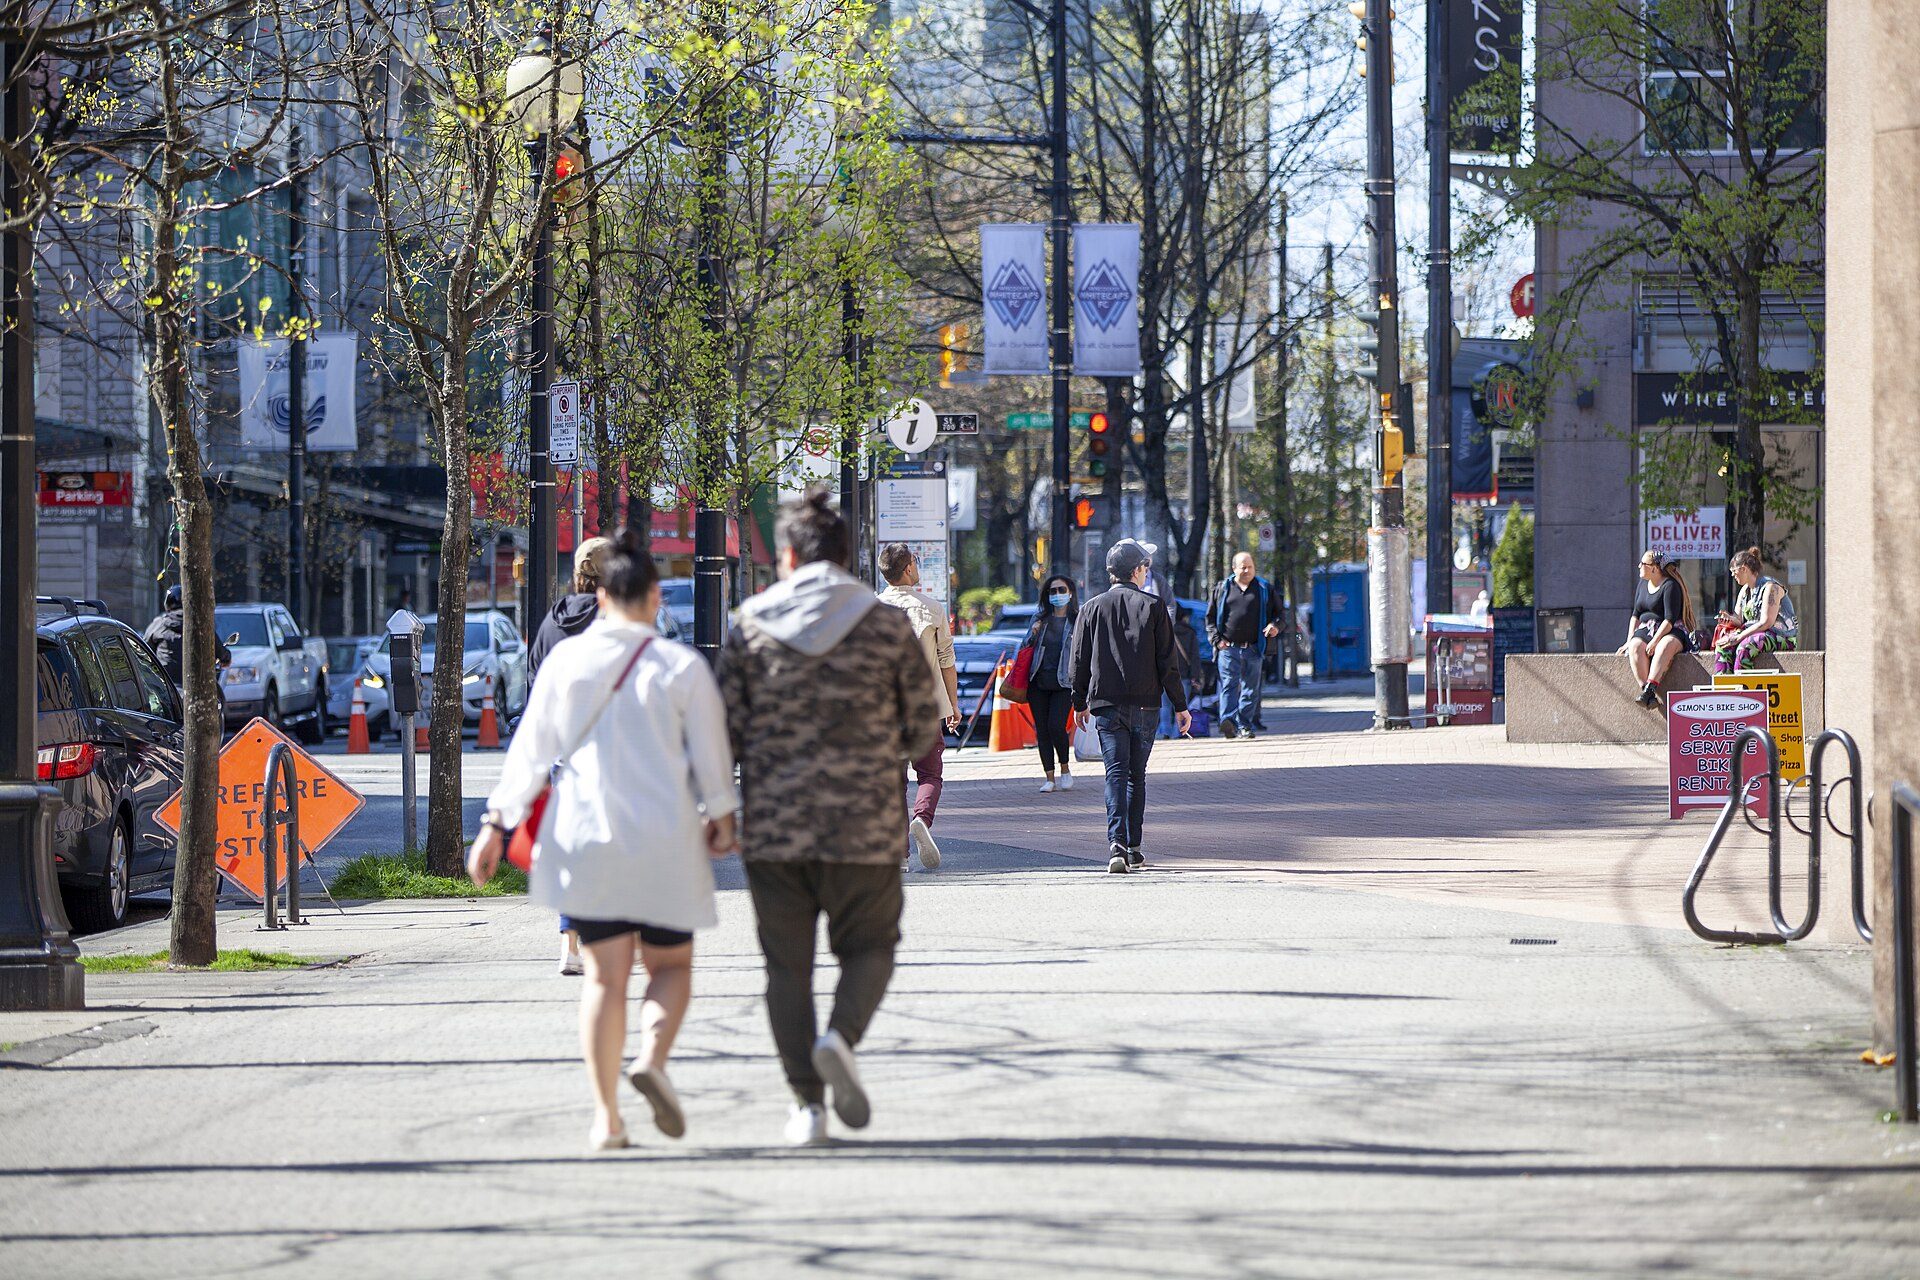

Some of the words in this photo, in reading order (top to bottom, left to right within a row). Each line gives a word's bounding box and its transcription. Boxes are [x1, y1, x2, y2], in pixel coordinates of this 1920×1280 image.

[1008, 300, 1021, 309] FC
[1097, 301, 1109, 309] FC
[1661, 391, 1727, 407] WINE
[1769, 391, 1826, 406] BEE
[943, 417, 953, 425] St
[56, 489, 104, 505] Parking
[1673, 509, 1701, 524] WE
[1651, 526, 1721, 541] DELIVER
[1652, 543, 1721, 553] 604-689-2827
[1676, 704, 1714, 712] SIMON'S
[1738, 703, 1760, 711] SHOP
[1690, 722, 1746, 738] SALES
[1781, 733, 1802, 745] Shop
[1680, 740, 1758, 755] SERVIE
[1698, 758, 1732, 772] BIK
[1780, 760, 1801, 770] Pizza
[216, 778, 327, 804] REPARE
[1678, 776, 1761, 791] RENTS
[223, 835, 288, 857] ST
